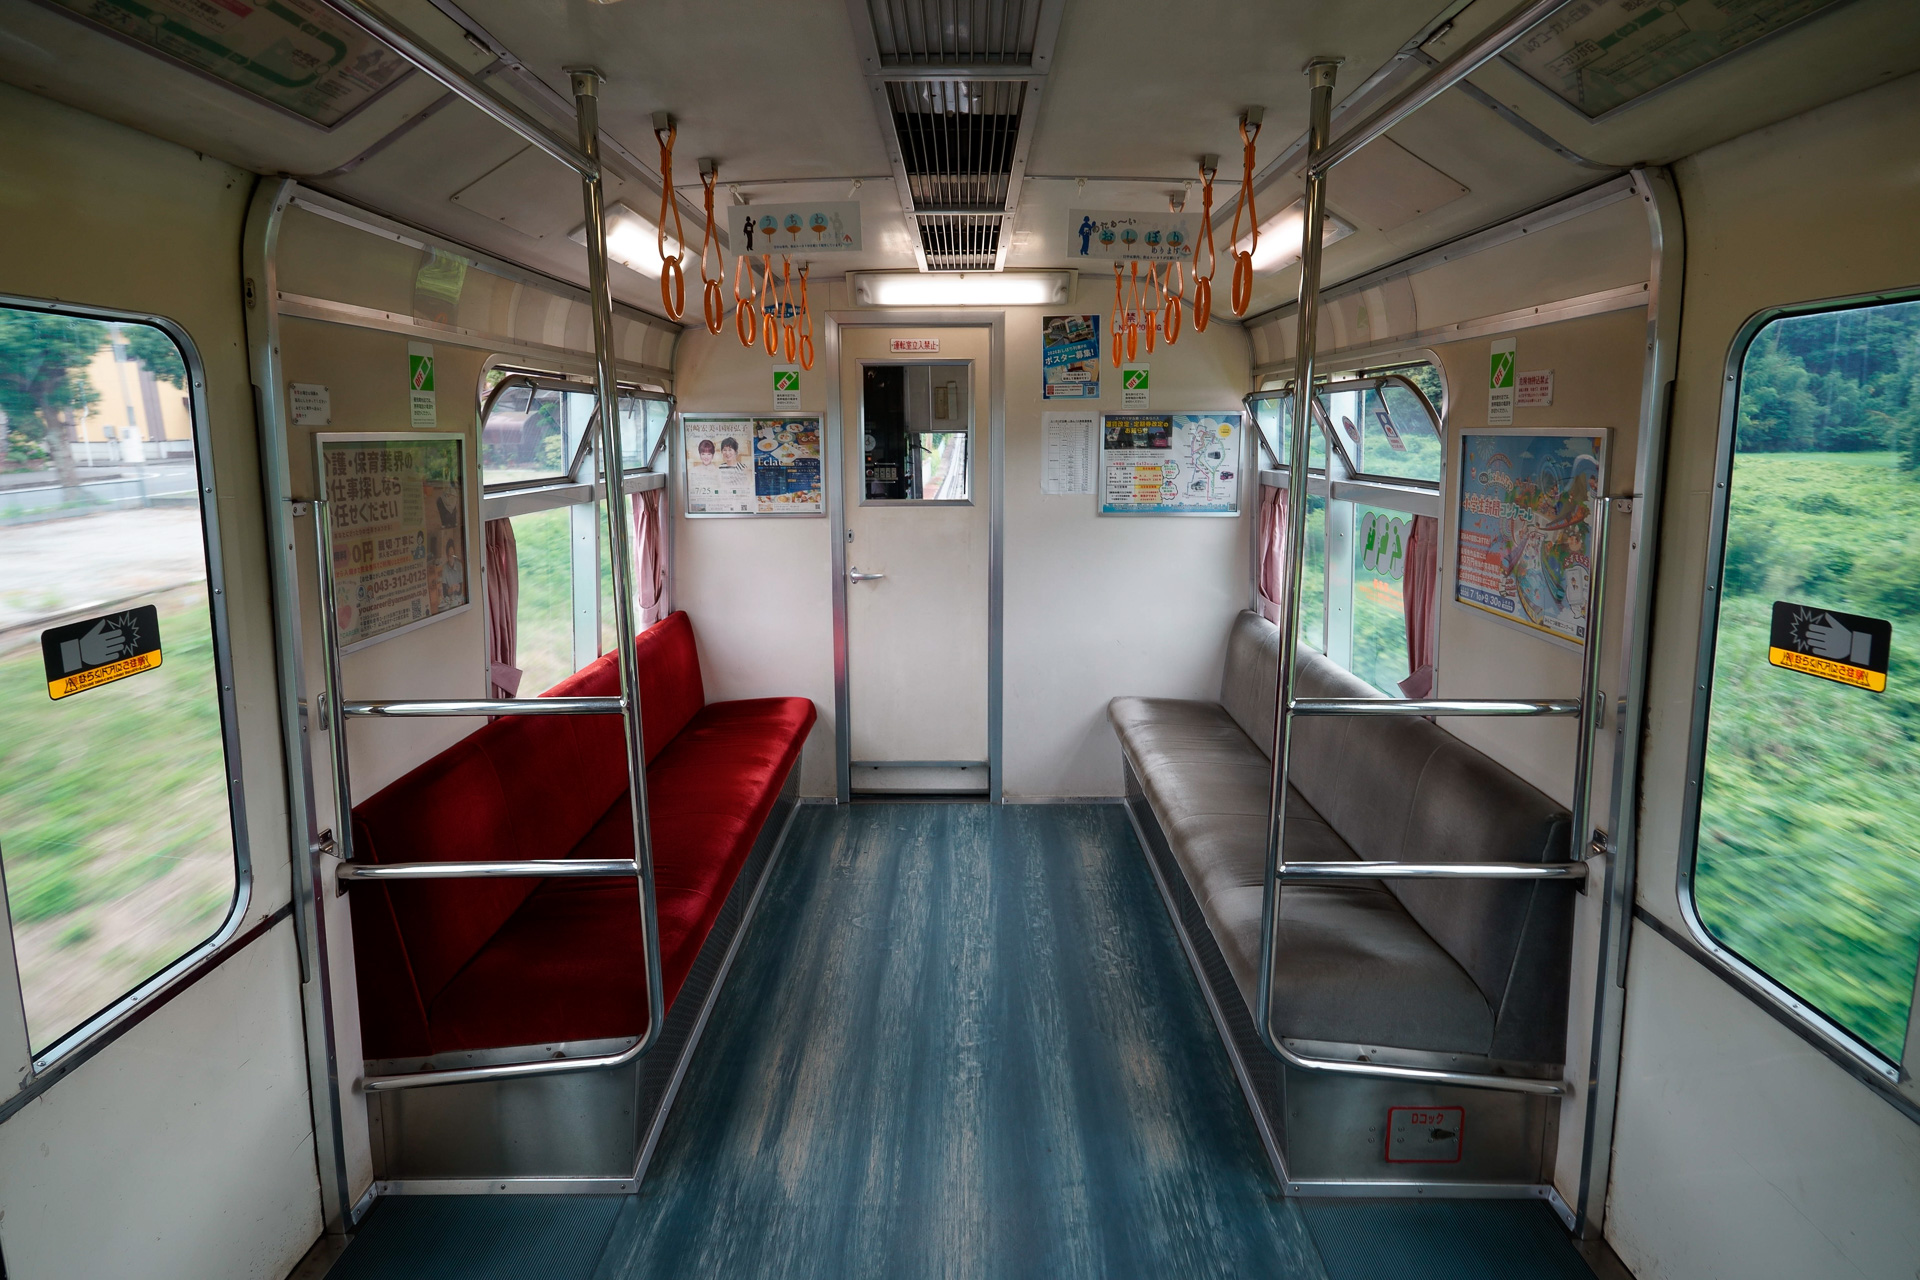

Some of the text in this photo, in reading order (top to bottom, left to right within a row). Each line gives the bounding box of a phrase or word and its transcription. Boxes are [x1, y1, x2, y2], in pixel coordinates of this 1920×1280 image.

[1550, 42, 1597, 72] ユーカリが丘
[893, 340, 937, 350] 運転室立入禁止
[1045, 348, 1095, 366] ポスター募集!
[414, 371, 424, 387] OFF
[779, 379, 788, 390] OFF
[1127, 377, 1137, 388] OFF
[1493, 368, 1503, 386] OFF
[1519, 375, 1549, 386] 危険物持込禁止
[695, 487, 711, 495] 7/25
[1463, 497, 1533, 521] 小学生新聞コンクール
[352, 540, 374, 563] 0円
[374, 568, 428, 594] 043-312-0125
[1411, 1112, 1444, 1125] Dコック
